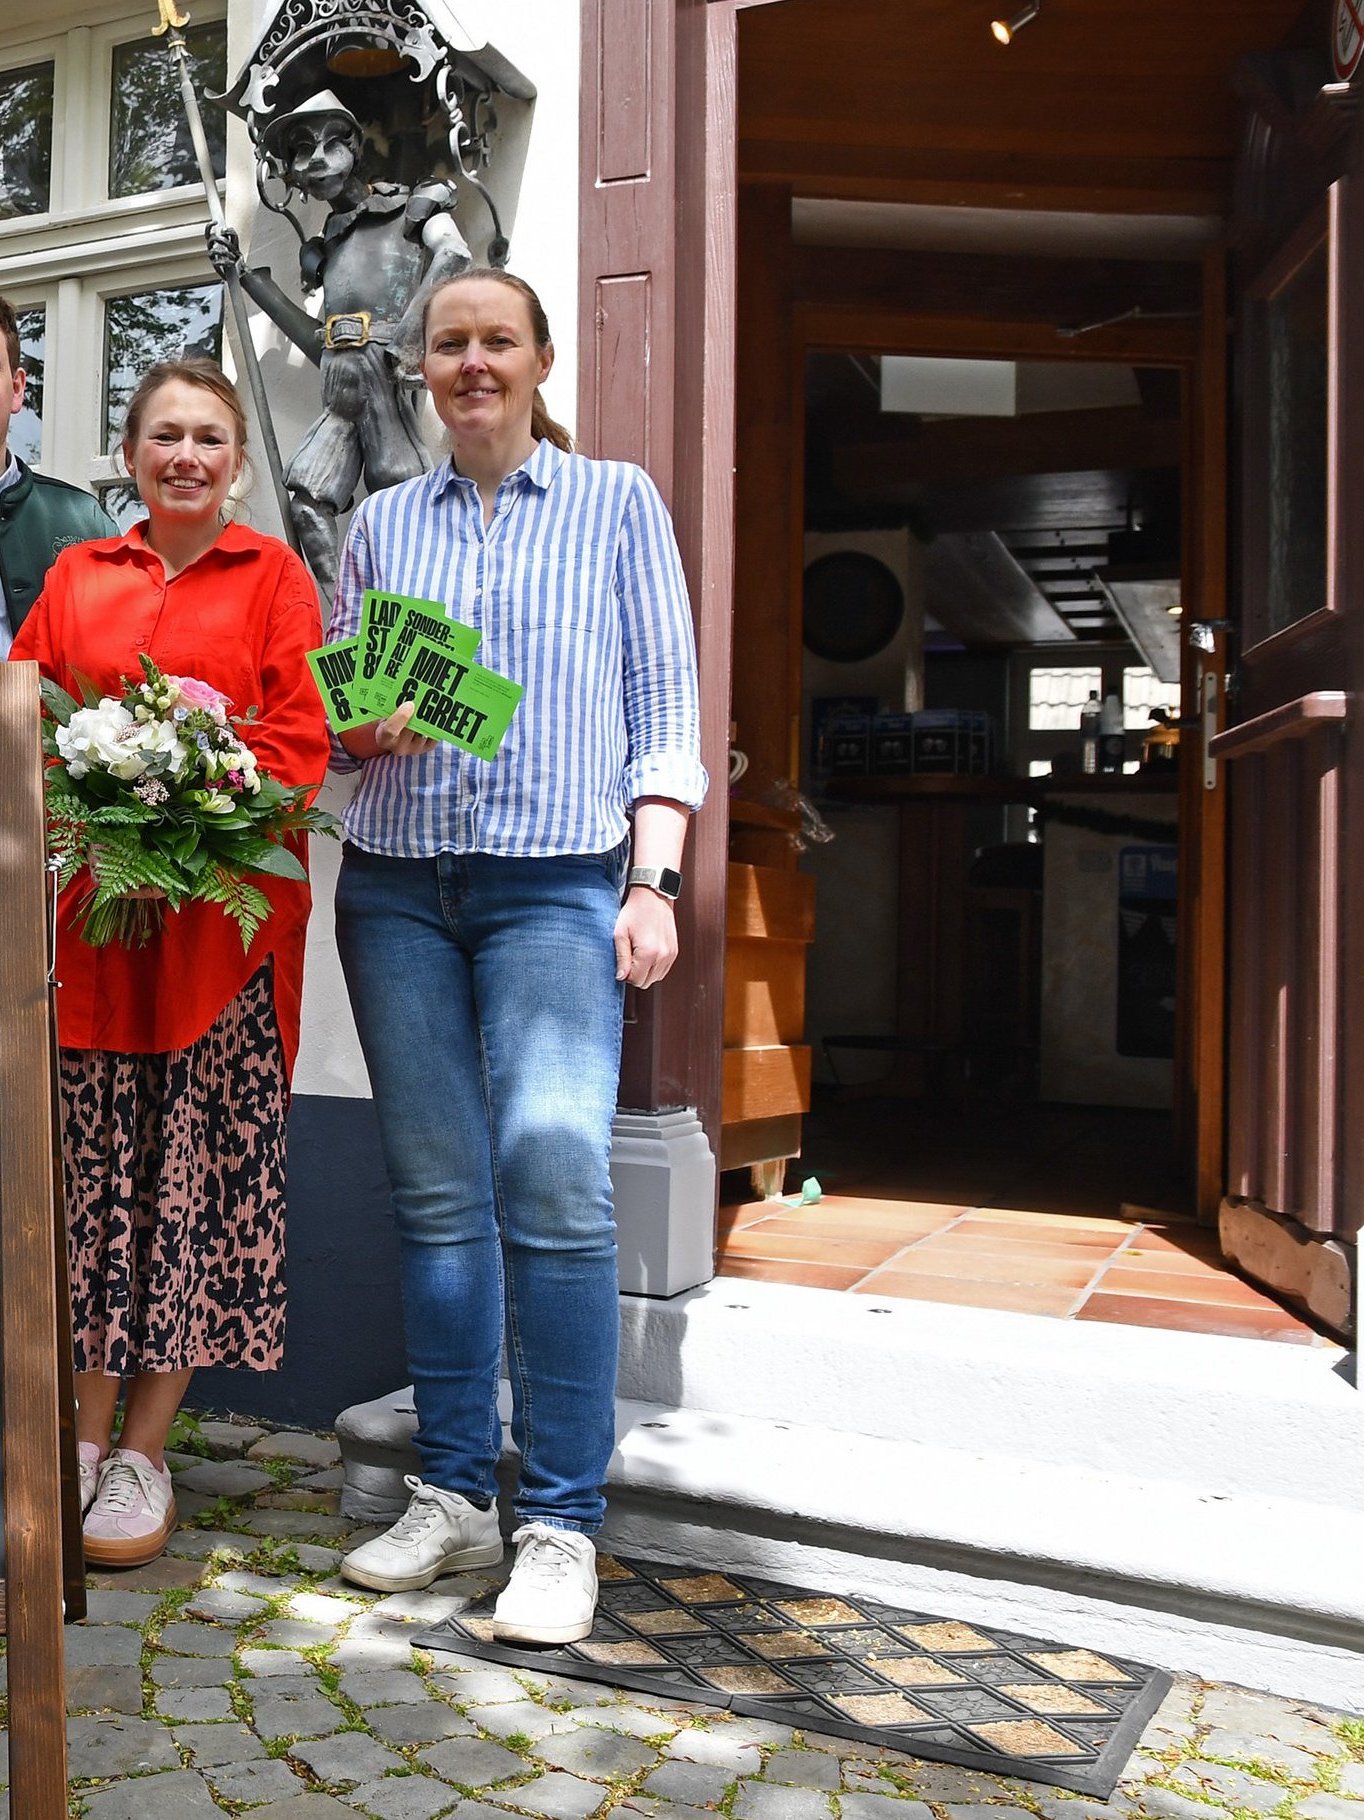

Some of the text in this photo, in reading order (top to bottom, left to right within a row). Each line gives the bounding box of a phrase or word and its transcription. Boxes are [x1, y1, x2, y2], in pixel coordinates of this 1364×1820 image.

[404, 609, 455, 643] SONDER-
[316, 644, 359, 690] MIE
[408, 646, 469, 697] MIET
[330, 687, 353, 722] &
[415, 688, 489, 745] GREET
